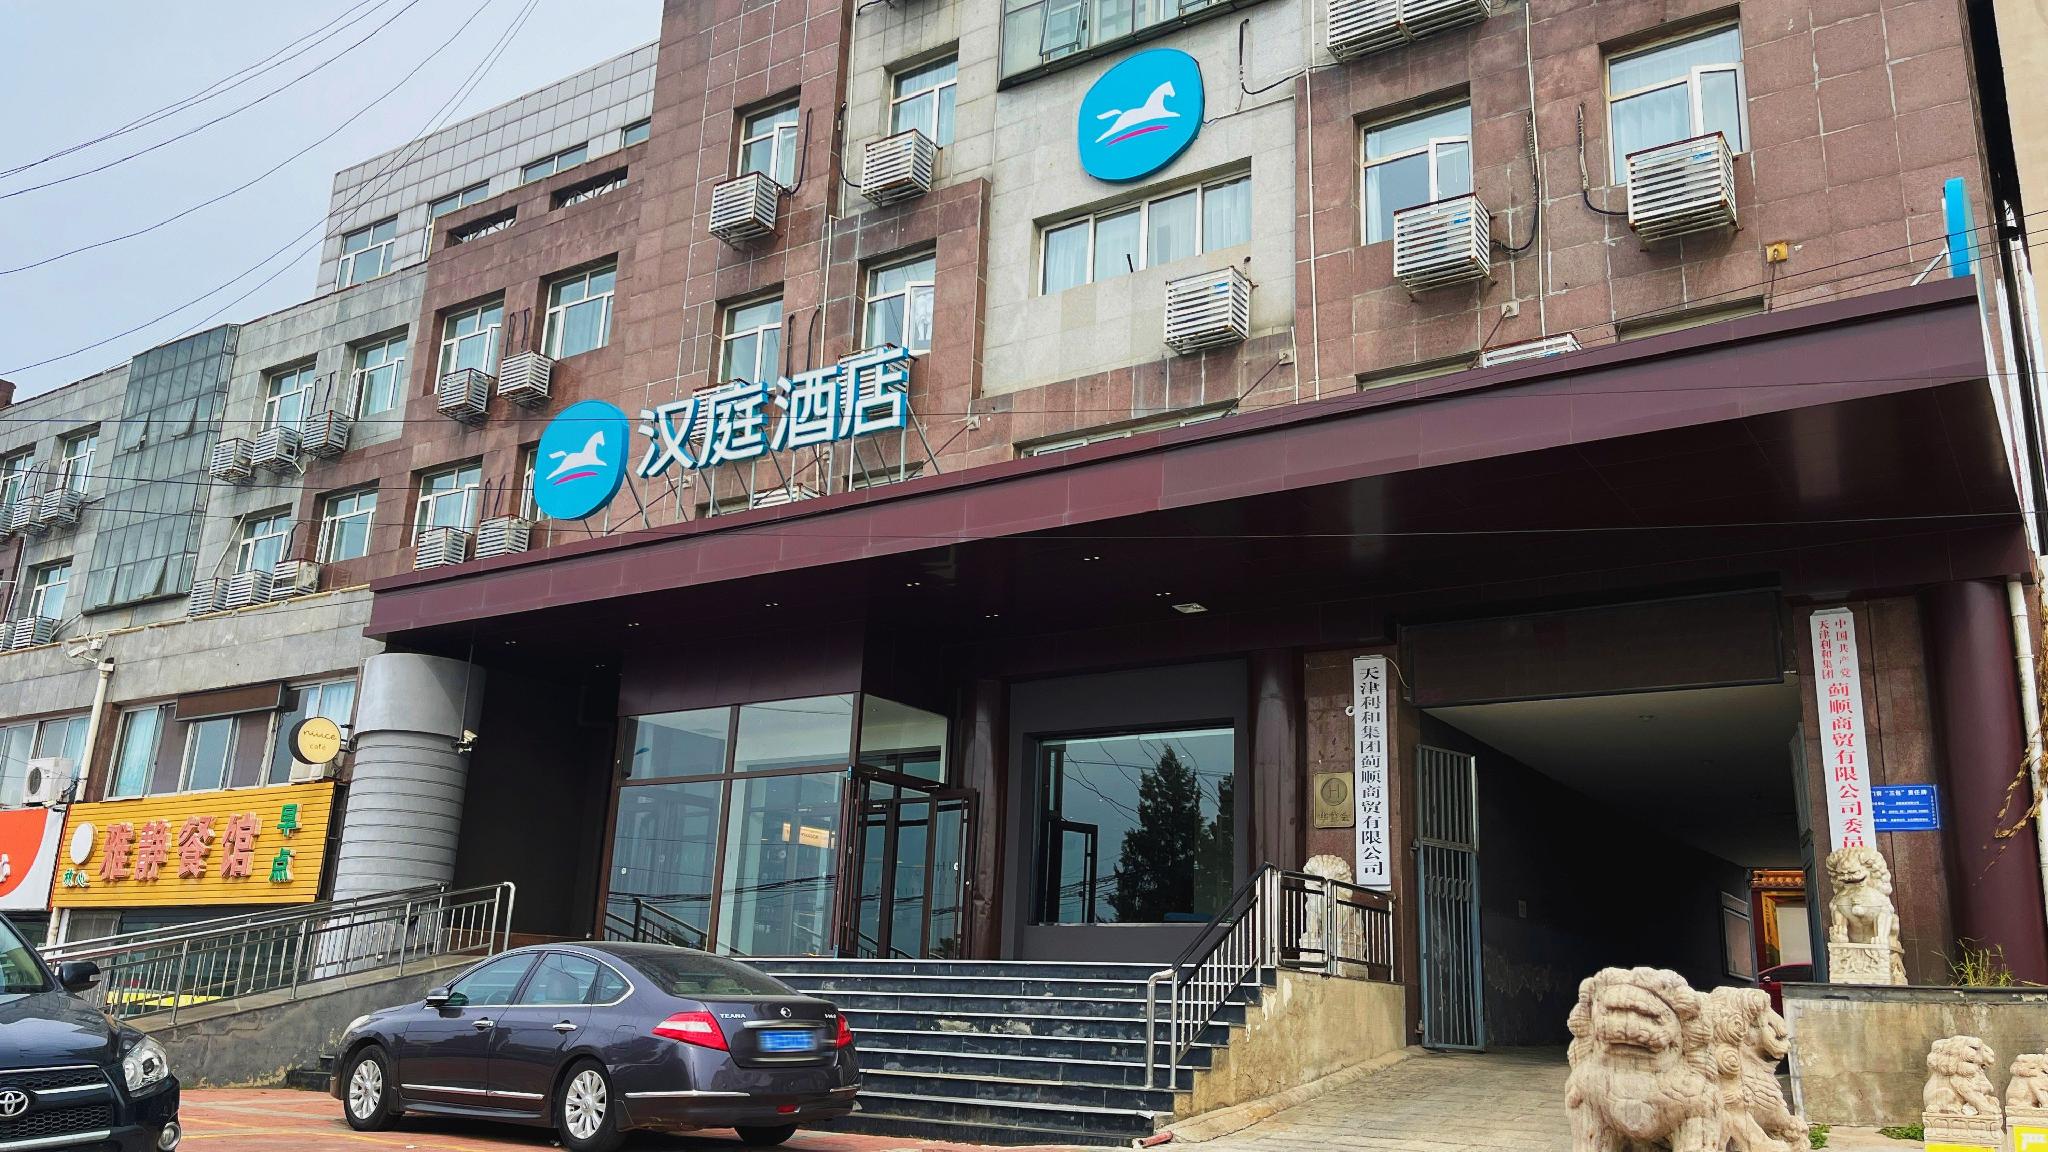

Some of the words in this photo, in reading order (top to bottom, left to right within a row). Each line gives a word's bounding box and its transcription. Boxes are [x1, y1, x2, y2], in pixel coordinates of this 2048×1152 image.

[636, 347, 909, 479] 汉庭酒店
[1818, 619, 1834, 680] 天津利和集团
[1835, 618, 1852, 678] 中国共产党
[1359, 665, 1384, 876] 天津利和集团蓟顺商贸有限公司
[99, 812, 262, 883] 雅静餐馆
[268, 803, 302, 884] 早点
